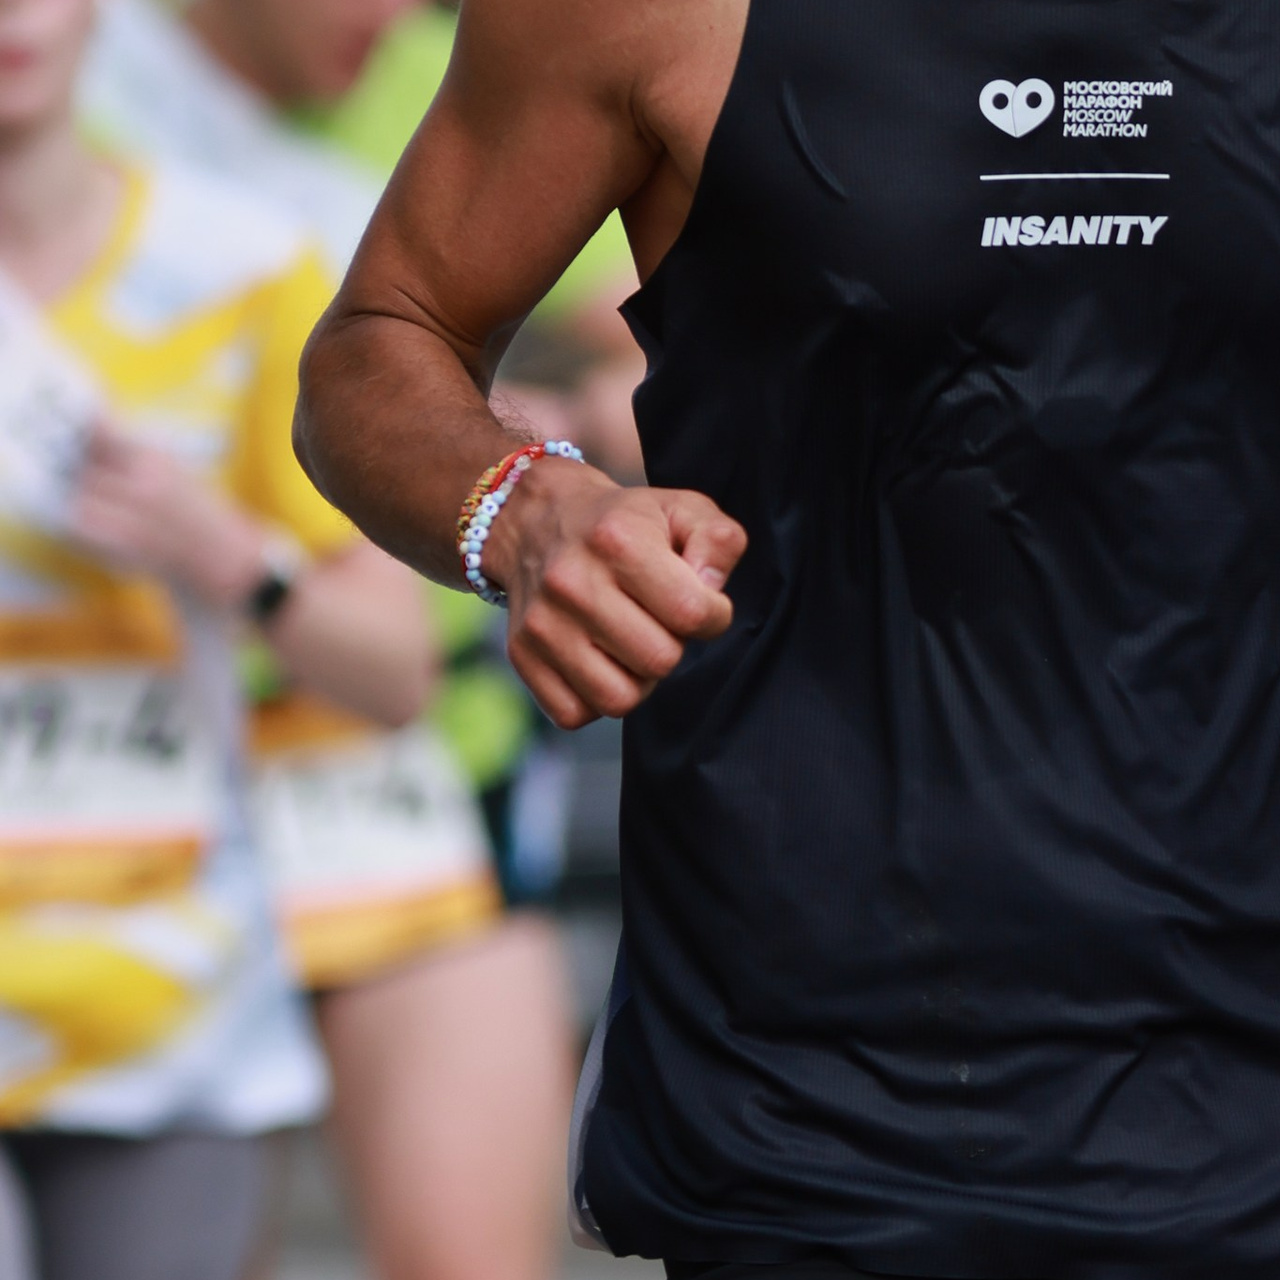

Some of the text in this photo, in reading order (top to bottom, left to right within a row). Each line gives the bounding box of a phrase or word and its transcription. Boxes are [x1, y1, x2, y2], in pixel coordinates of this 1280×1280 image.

[1063, 79, 1174, 96] МОСКОВСКИЙ
[1063, 95, 1142, 109] МАРАФОН
[1063, 109, 1133, 122] MOSCOW
[1062, 123, 1148, 137] MARATHON
[980, 215, 1169, 247] INSANITY
